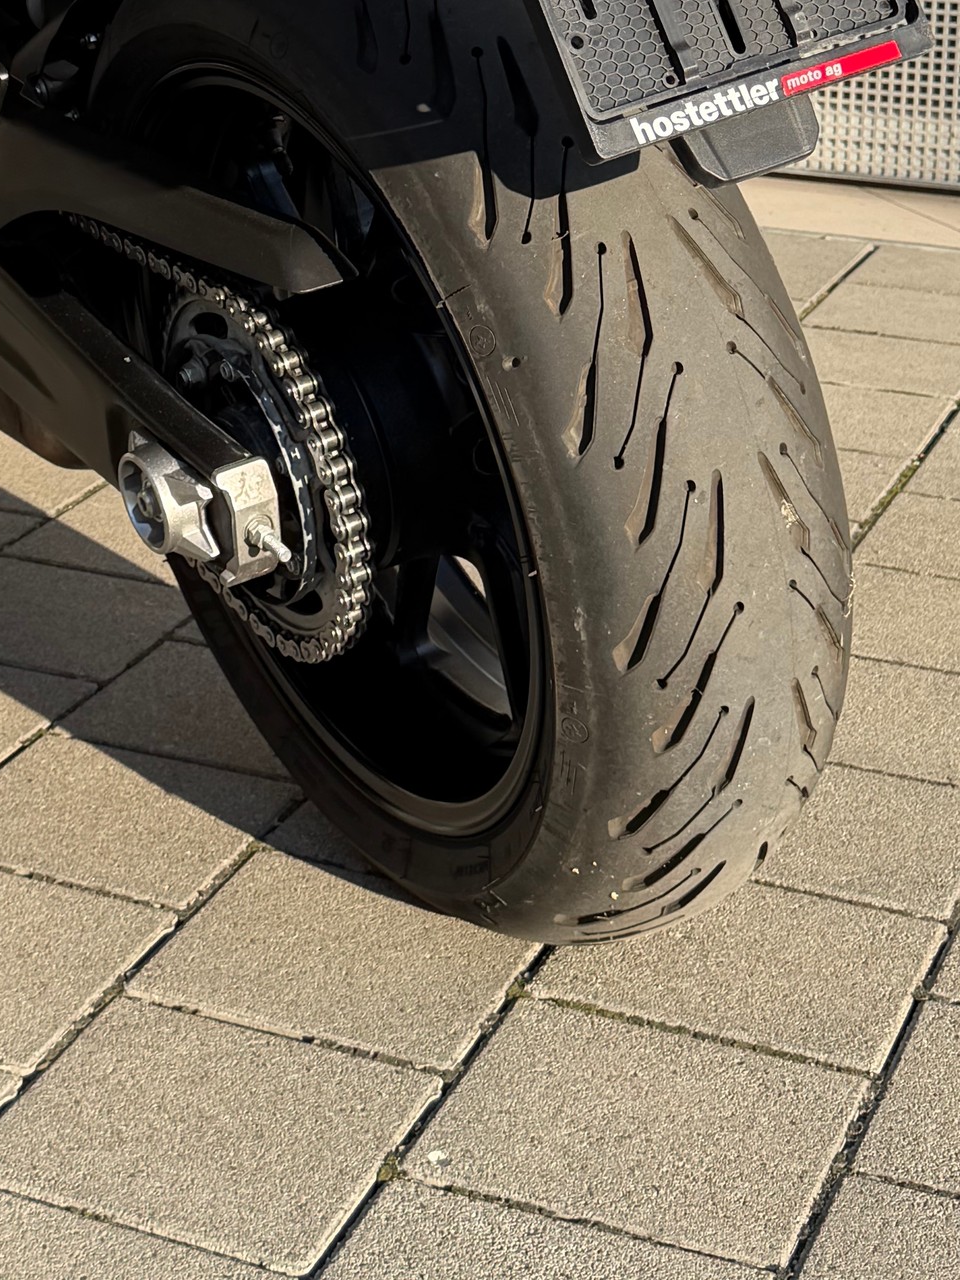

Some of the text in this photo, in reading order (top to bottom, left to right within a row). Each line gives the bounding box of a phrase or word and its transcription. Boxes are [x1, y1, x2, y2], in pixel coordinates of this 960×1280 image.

[629, 62, 843, 144] hostettler moto ag
